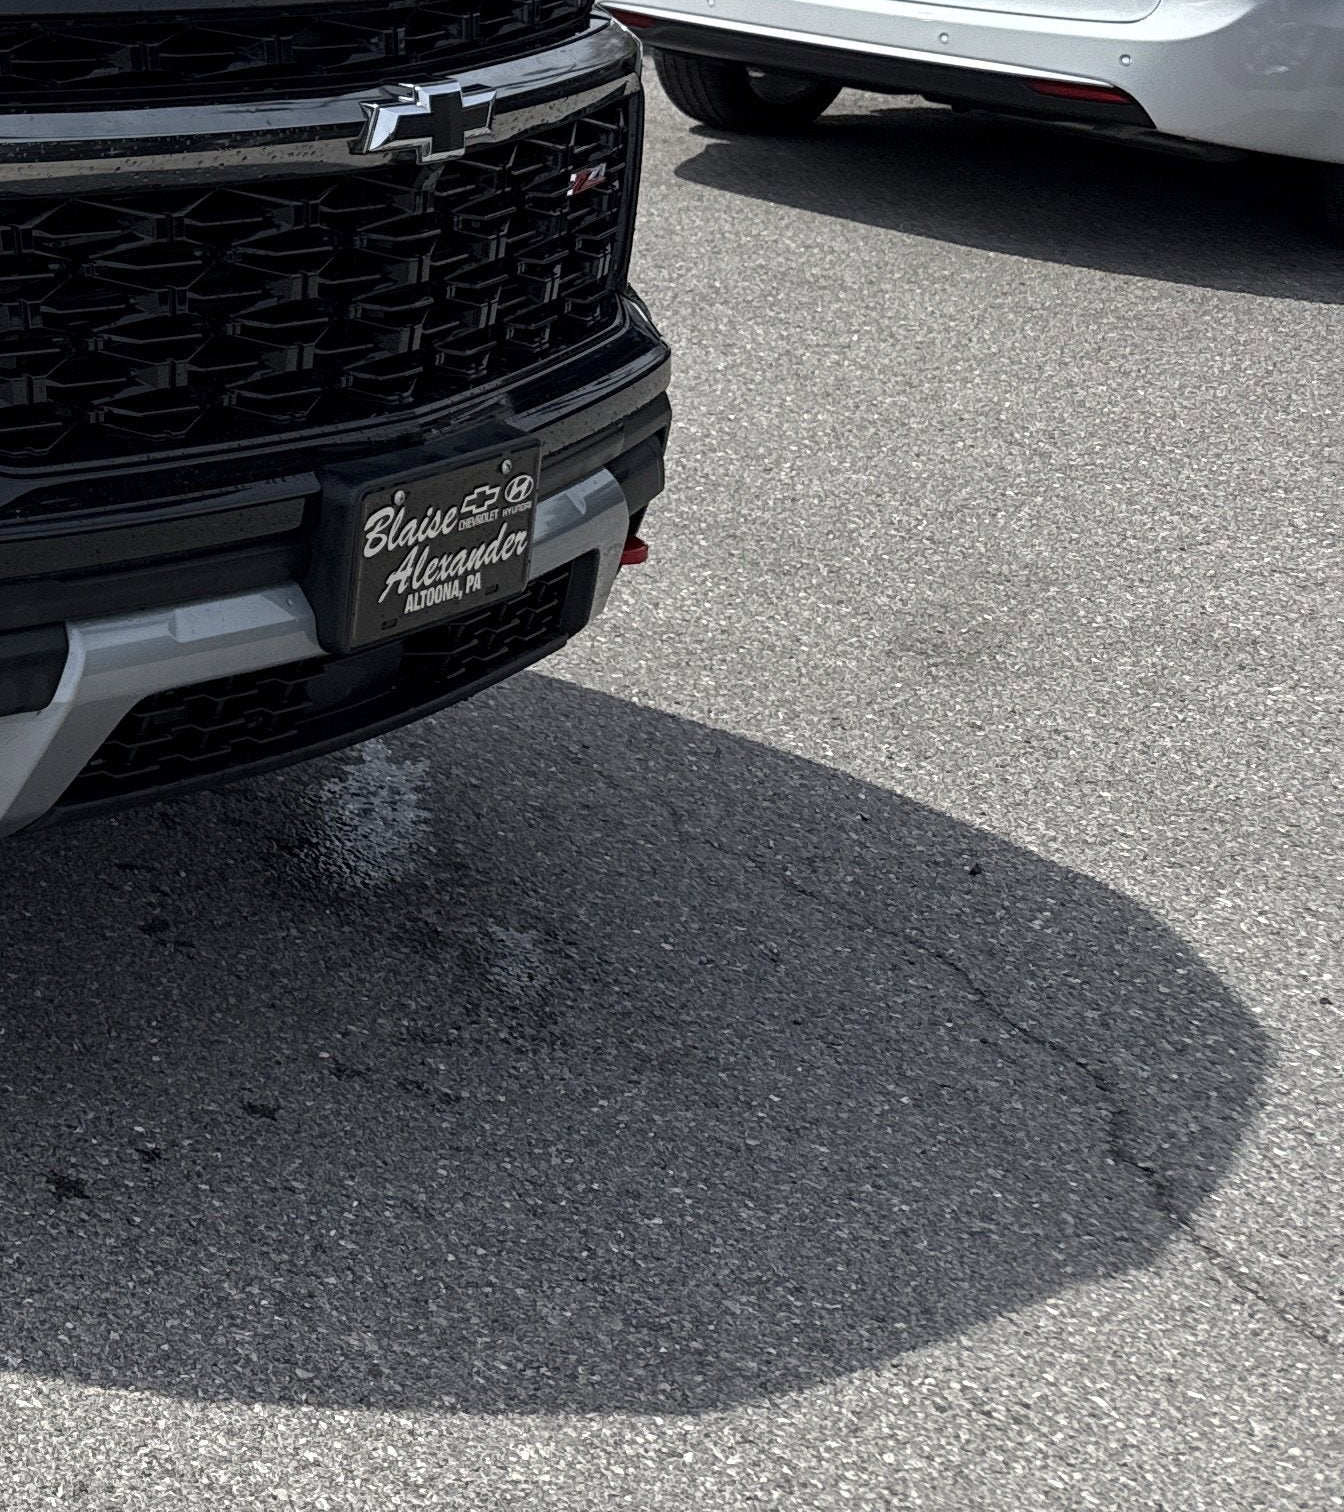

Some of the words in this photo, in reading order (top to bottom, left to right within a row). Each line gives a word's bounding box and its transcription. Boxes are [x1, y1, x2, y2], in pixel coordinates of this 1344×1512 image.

[363, 506, 459, 558] Blaise
[457, 507, 501, 532] CHEVROLET
[377, 521, 529, 605] Alexander
[403, 579, 464, 615] ALTOONA,
[464, 571, 483, 595] PA
